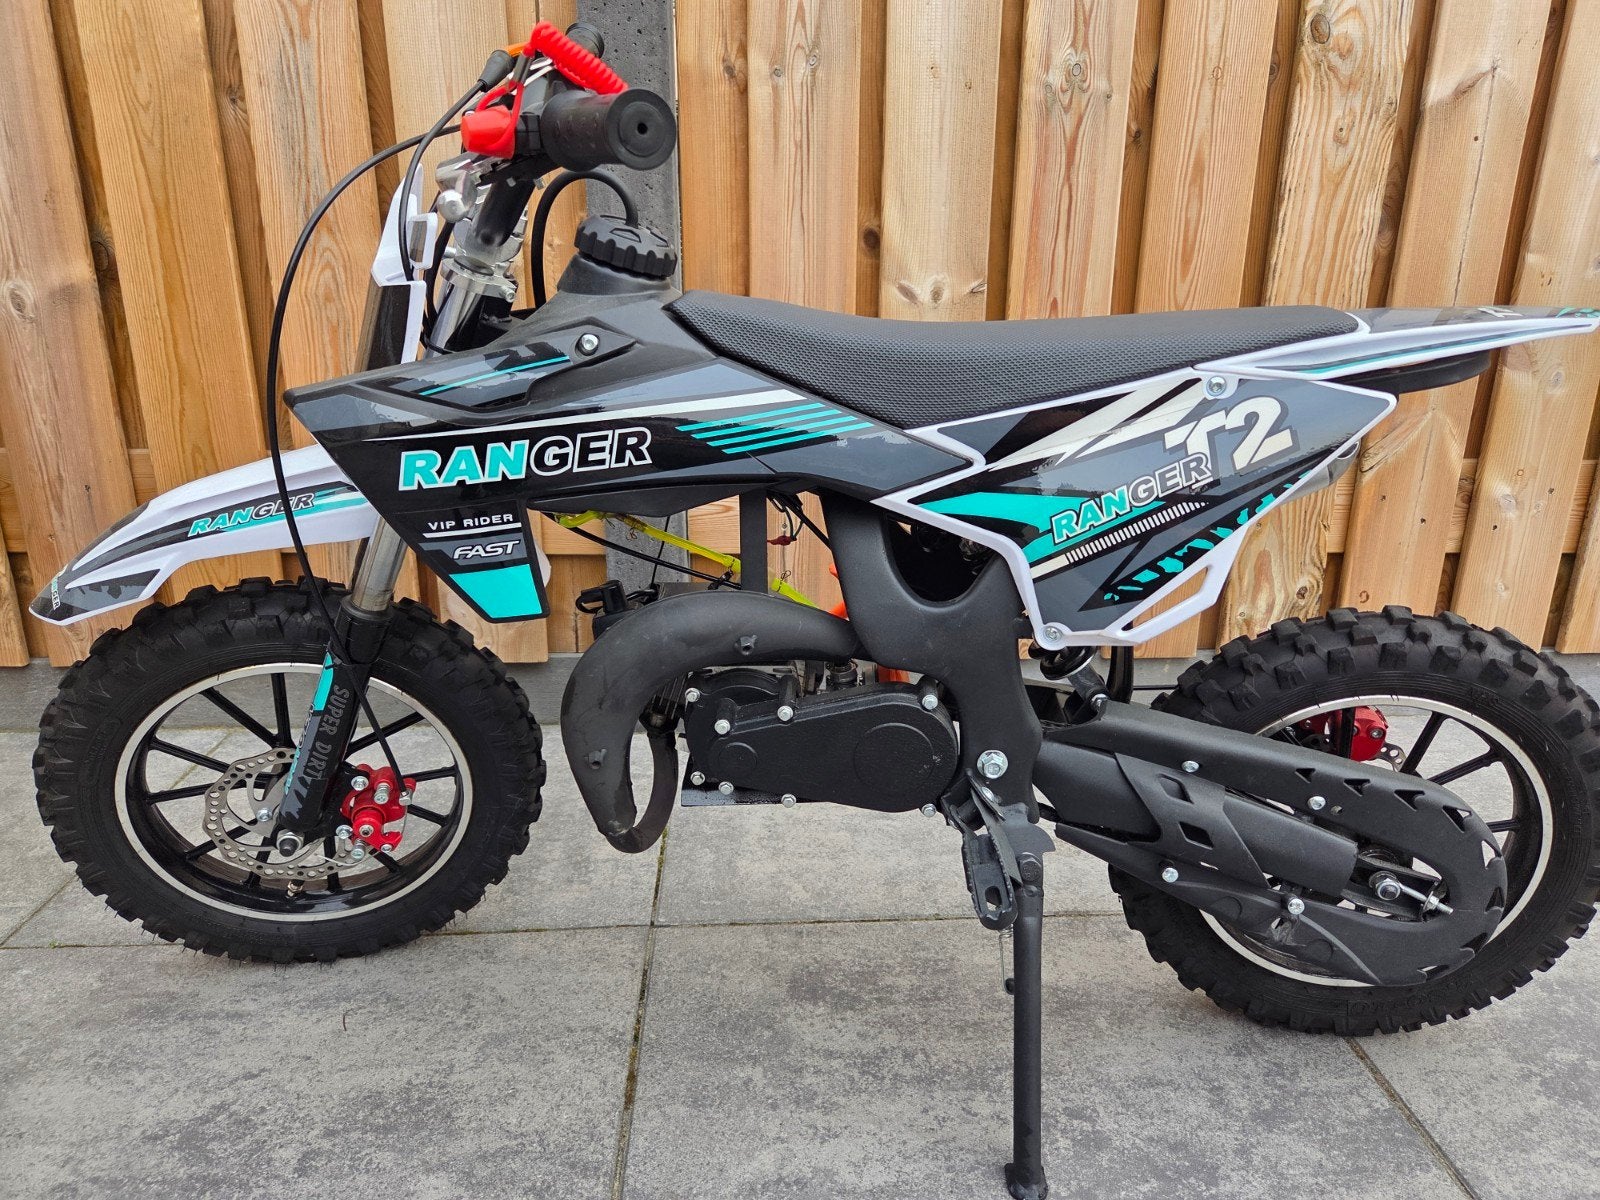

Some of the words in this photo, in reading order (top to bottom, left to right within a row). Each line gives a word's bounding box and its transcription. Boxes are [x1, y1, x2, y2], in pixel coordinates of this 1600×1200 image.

[398, 426, 653, 491] RANGER
[1164, 396, 1293, 471] T2
[427, 520, 456, 531] VIP
[462, 513, 514, 528] RIDER
[1050, 453, 1213, 546] RANGER
[453, 540, 520, 560] FAST
[319, 684, 350, 736] SUPER
[304, 741, 333, 780] DIRT
